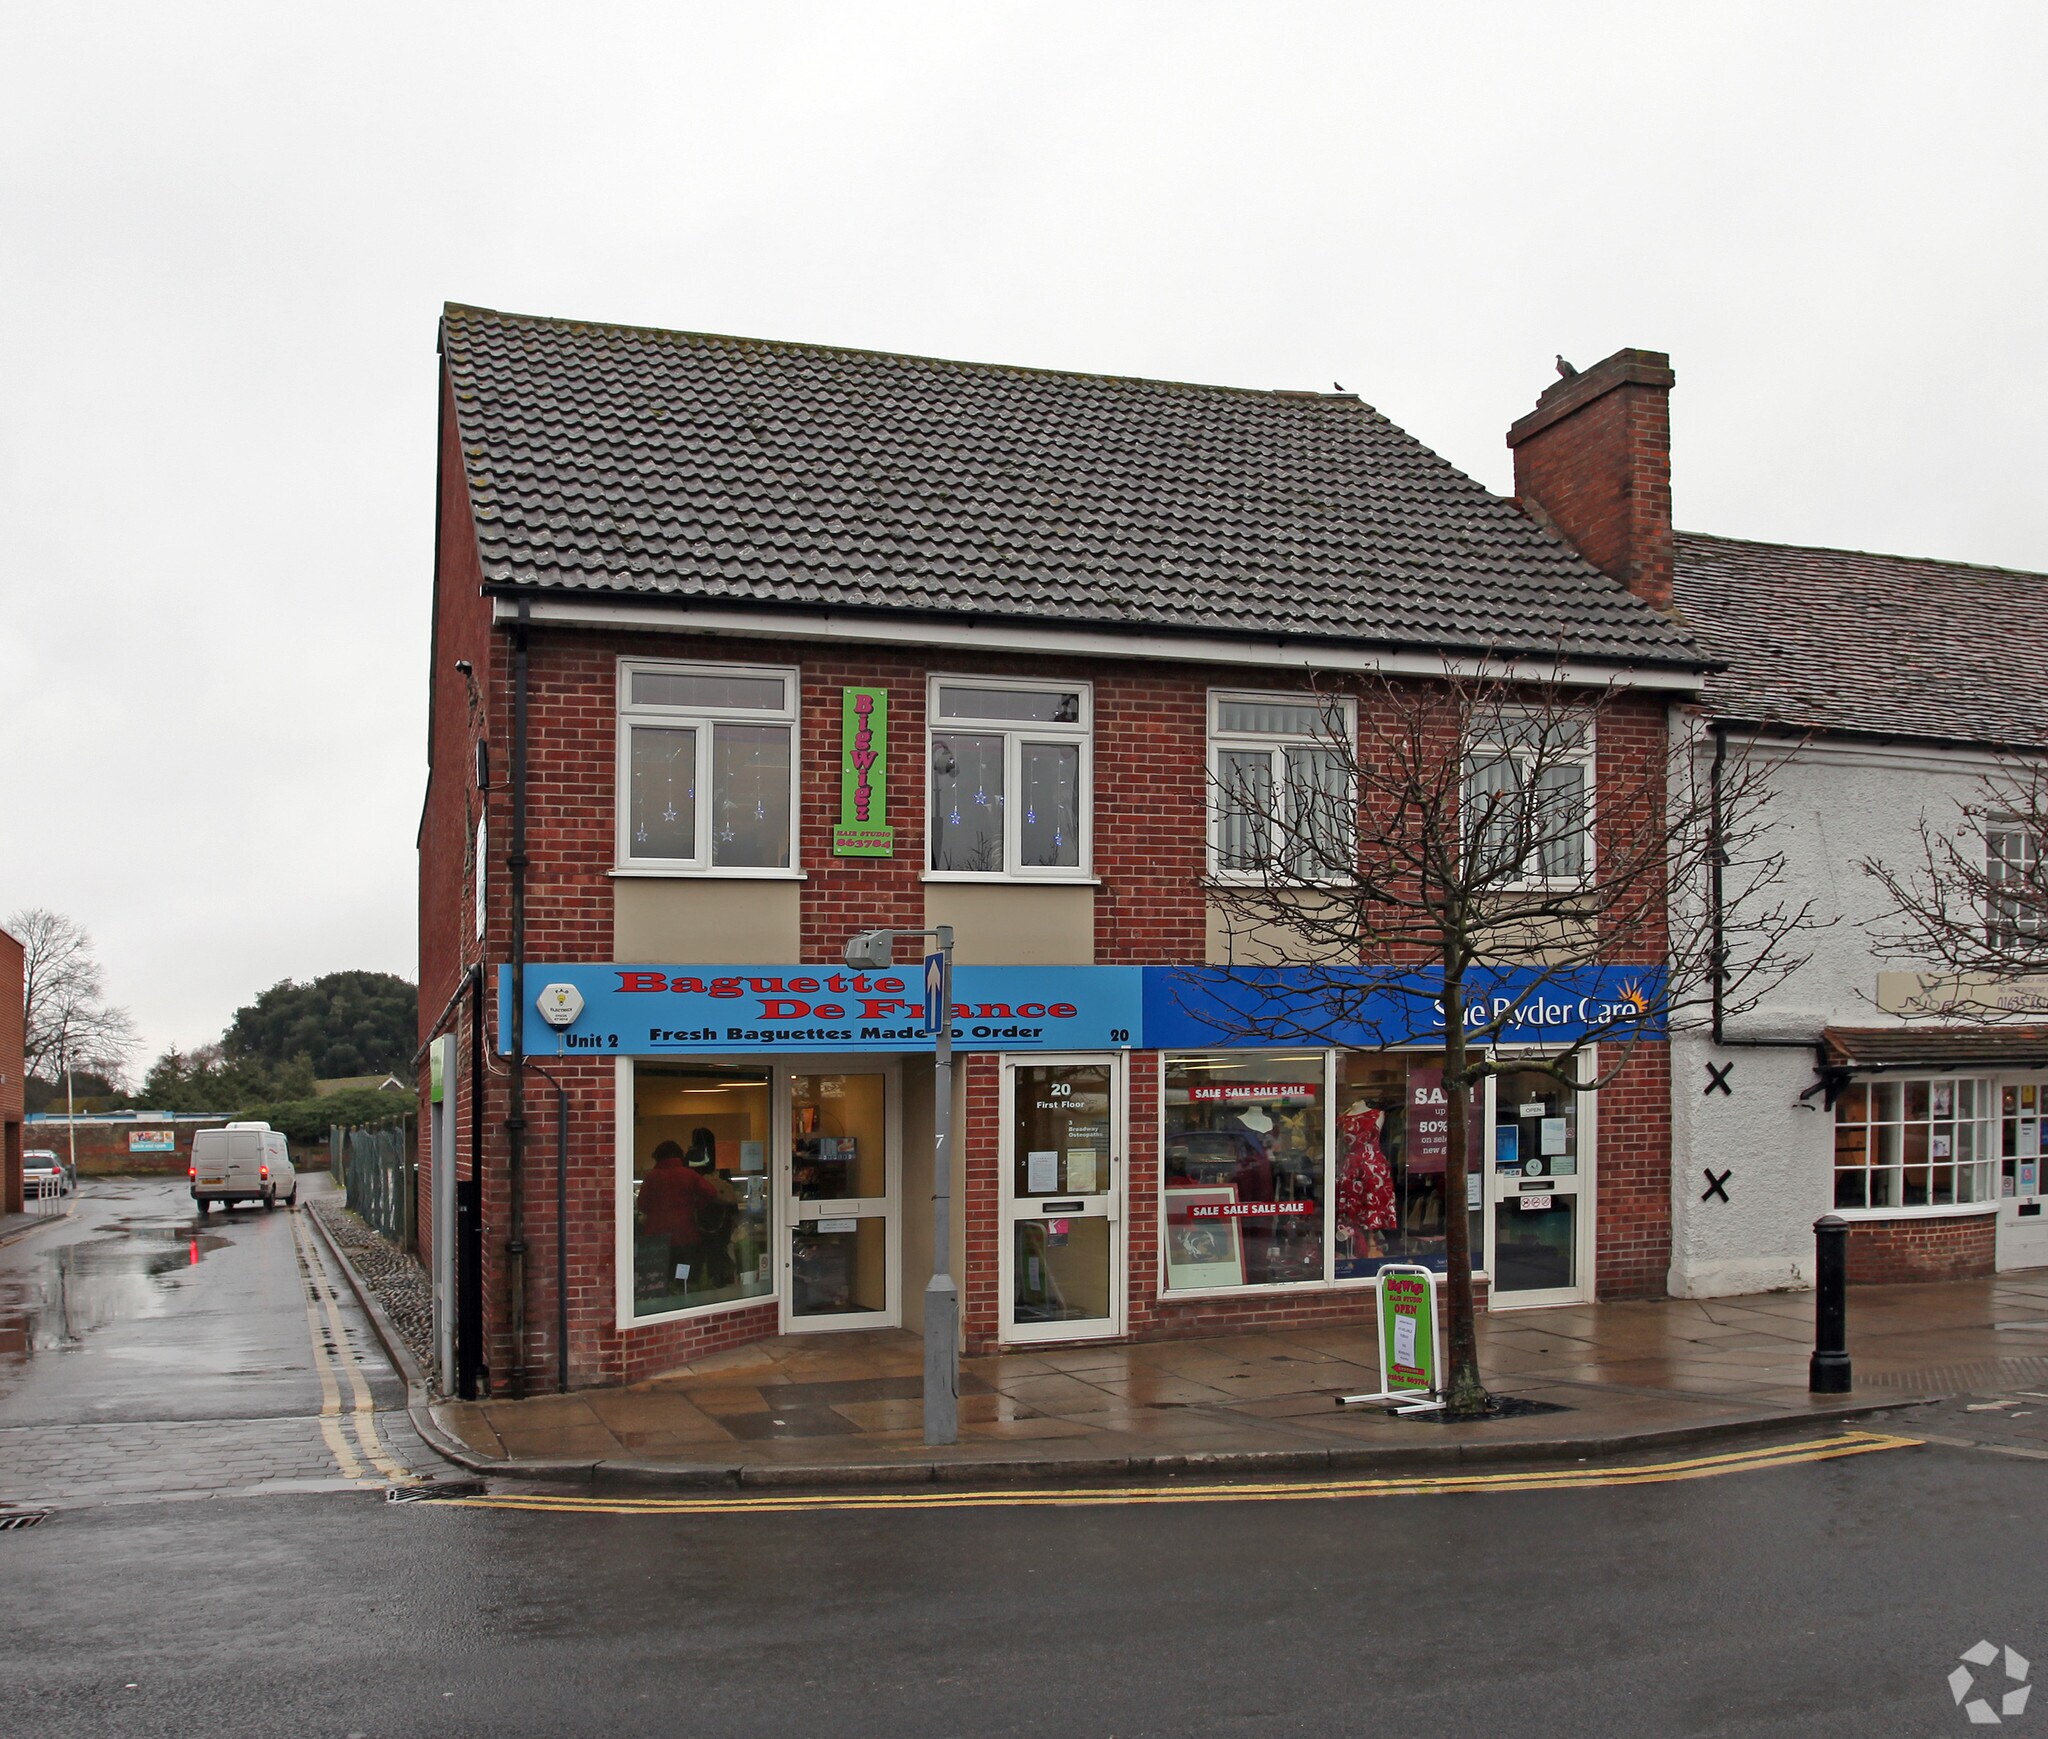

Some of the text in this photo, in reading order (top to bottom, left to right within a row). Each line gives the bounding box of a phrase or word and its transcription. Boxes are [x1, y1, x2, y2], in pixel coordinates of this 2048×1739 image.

[613, 971, 906, 998] Baguette
[755, 999, 845, 1019] De
[1493, 997, 1573, 1030] Ryder
[1578, 996, 1637, 1024] Care
[650, 1028, 717, 1041] Fresh
[727, 1028, 852, 1042] Baguettes
[860, 1027, 929, 1040] Made
[971, 1025, 1043, 1038] Order
[1110, 1029, 1129, 1042] 20
[566, 1033, 618, 1048] Unit 2
[1050, 1083, 1072, 1096] 20
[1195, 1086, 1305, 1099] SALE SALE SALE SALE
[1414, 1087, 1475, 1105] SA!
[1036, 1101, 1059, 1109] First
[1435, 1108, 1446, 1117] up
[1419, 1121, 1448, 1133] 50%
[935, 1134, 945, 1149] 7
[1421, 1136, 1432, 1144] on
[1193, 1203, 1304, 1216] SALE SALE SALE SALE
[1395, 1304, 1417, 1314] OPEN
